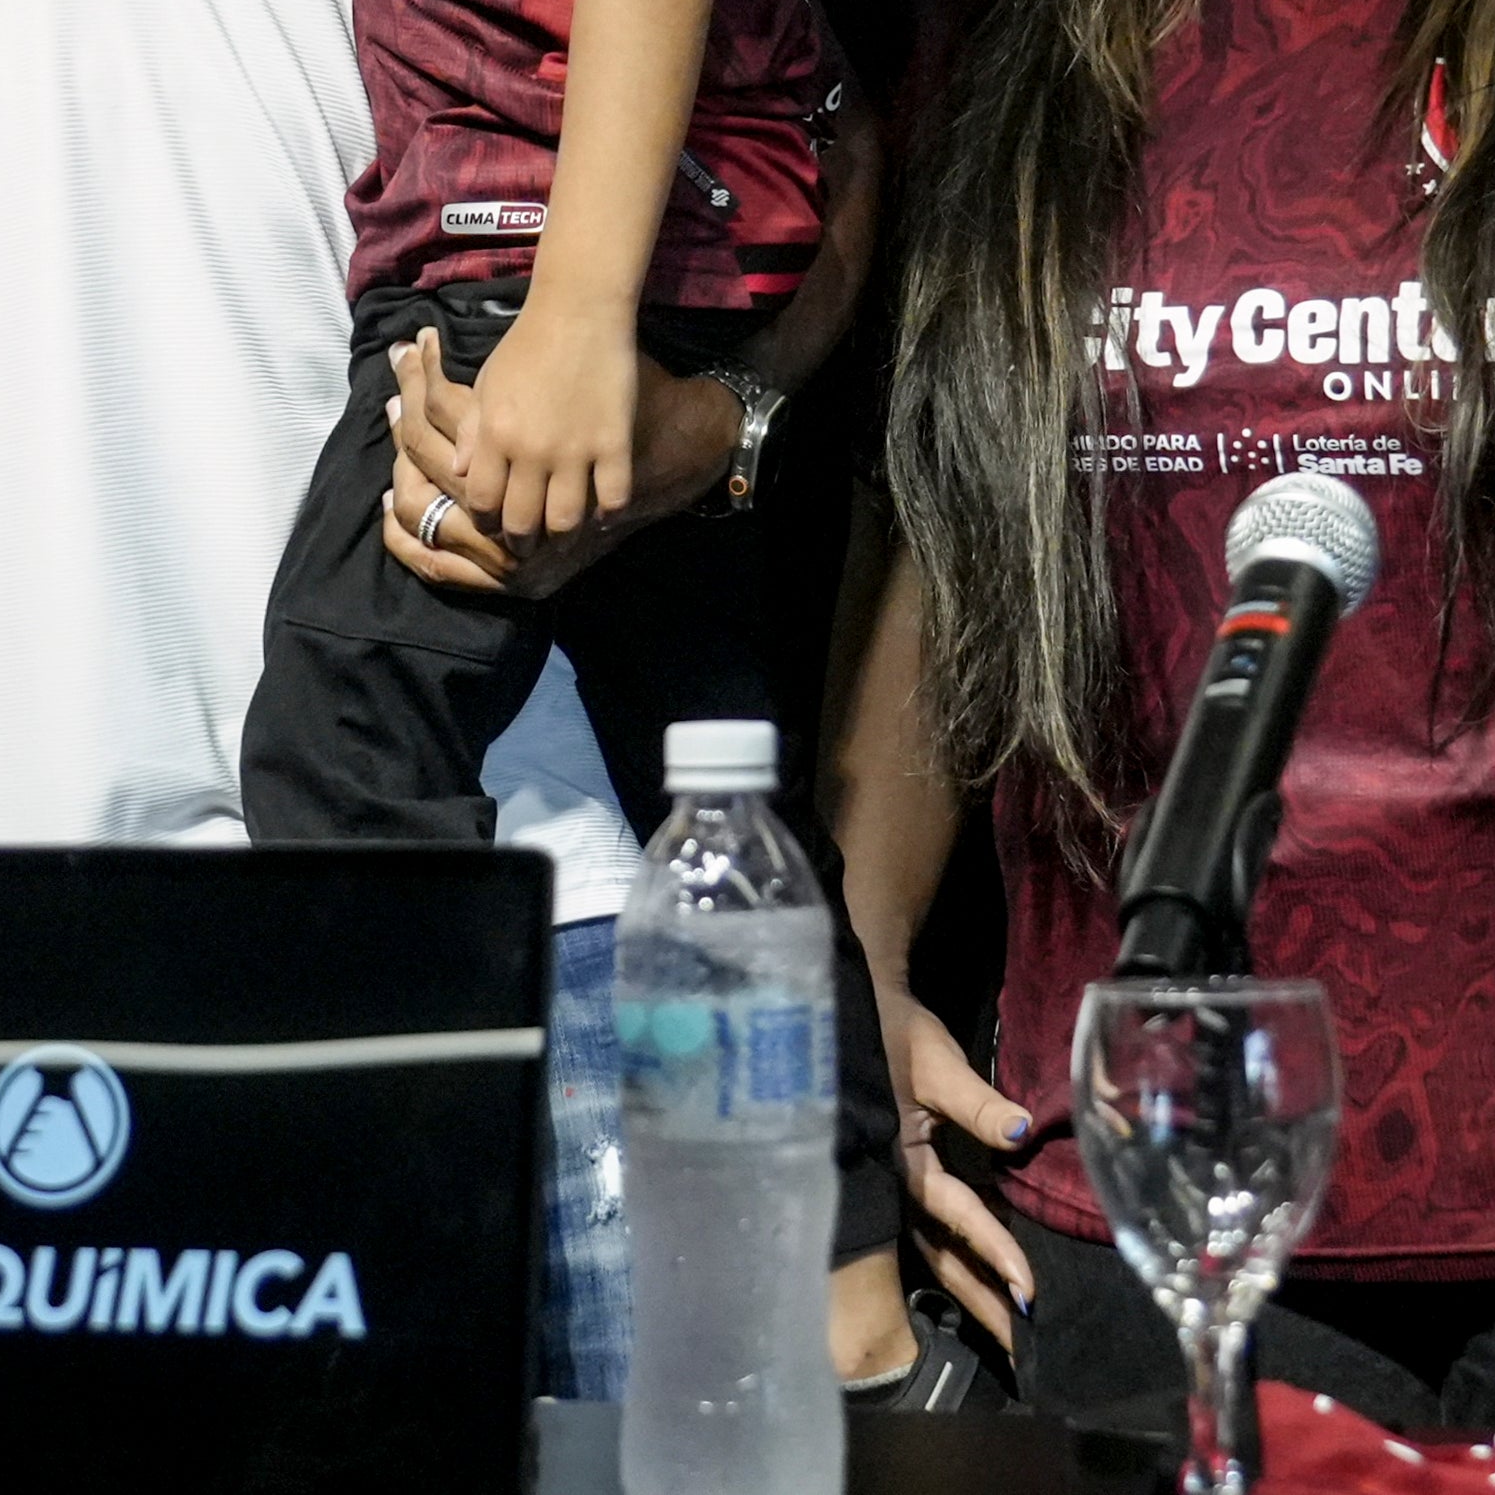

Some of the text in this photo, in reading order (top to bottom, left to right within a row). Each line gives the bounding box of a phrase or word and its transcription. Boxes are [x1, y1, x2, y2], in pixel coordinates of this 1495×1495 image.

[446, 211, 542, 225] CLIMA TECH
[1143, 434, 1202, 451] PARA
[1293, 433, 1401, 451] Lotería de
[1144, 457, 1204, 472] EDAD
